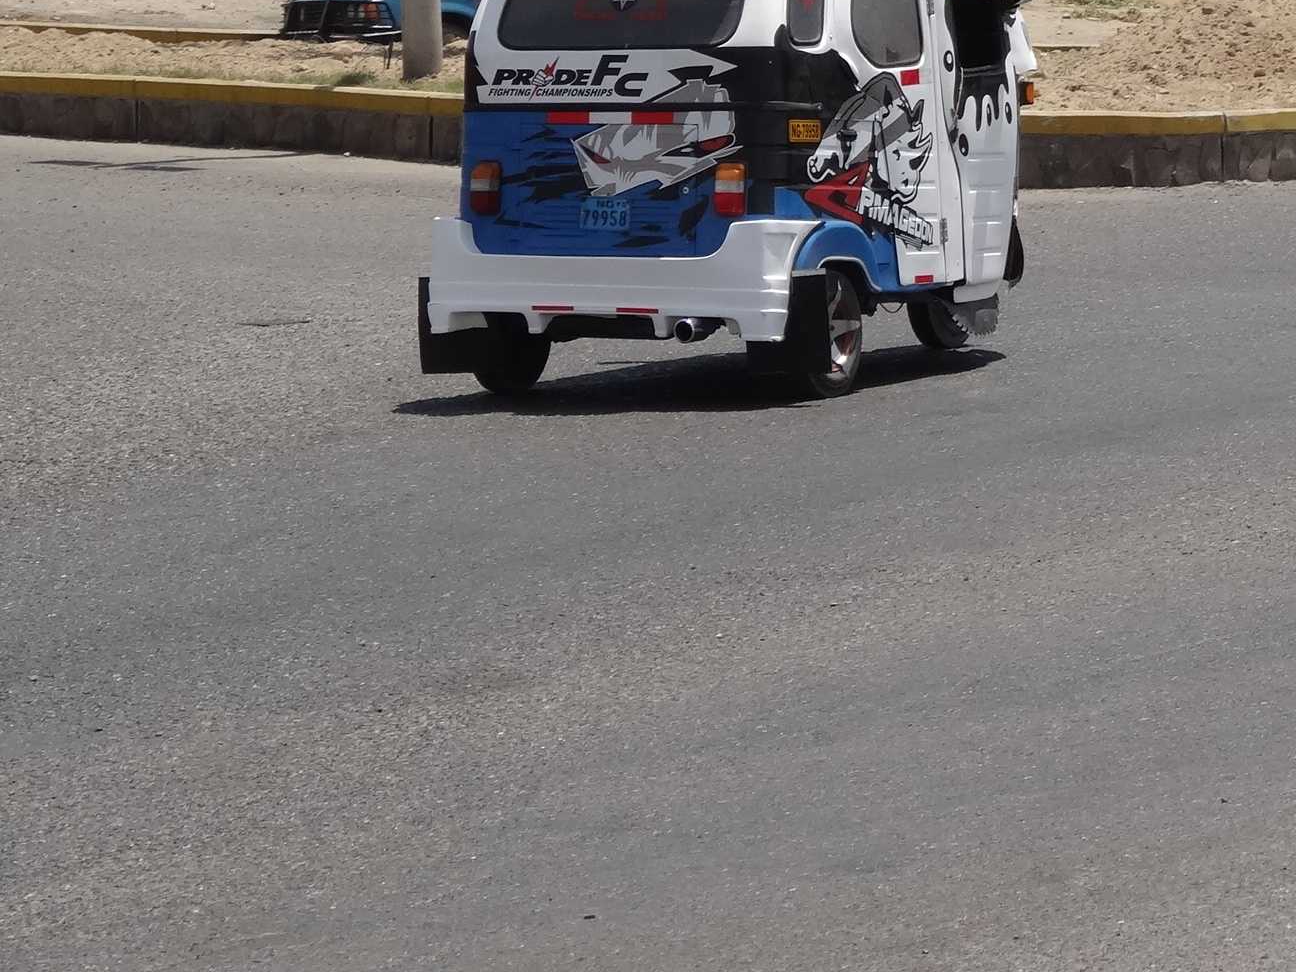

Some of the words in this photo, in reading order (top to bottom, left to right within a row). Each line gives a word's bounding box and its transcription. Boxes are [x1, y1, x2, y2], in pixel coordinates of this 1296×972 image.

[591, 54, 648, 97] FC
[488, 88, 531, 98] FIGHTING
[535, 88, 613, 98] CHAMPIONSHIPS
[583, 210, 626, 227] 79958
